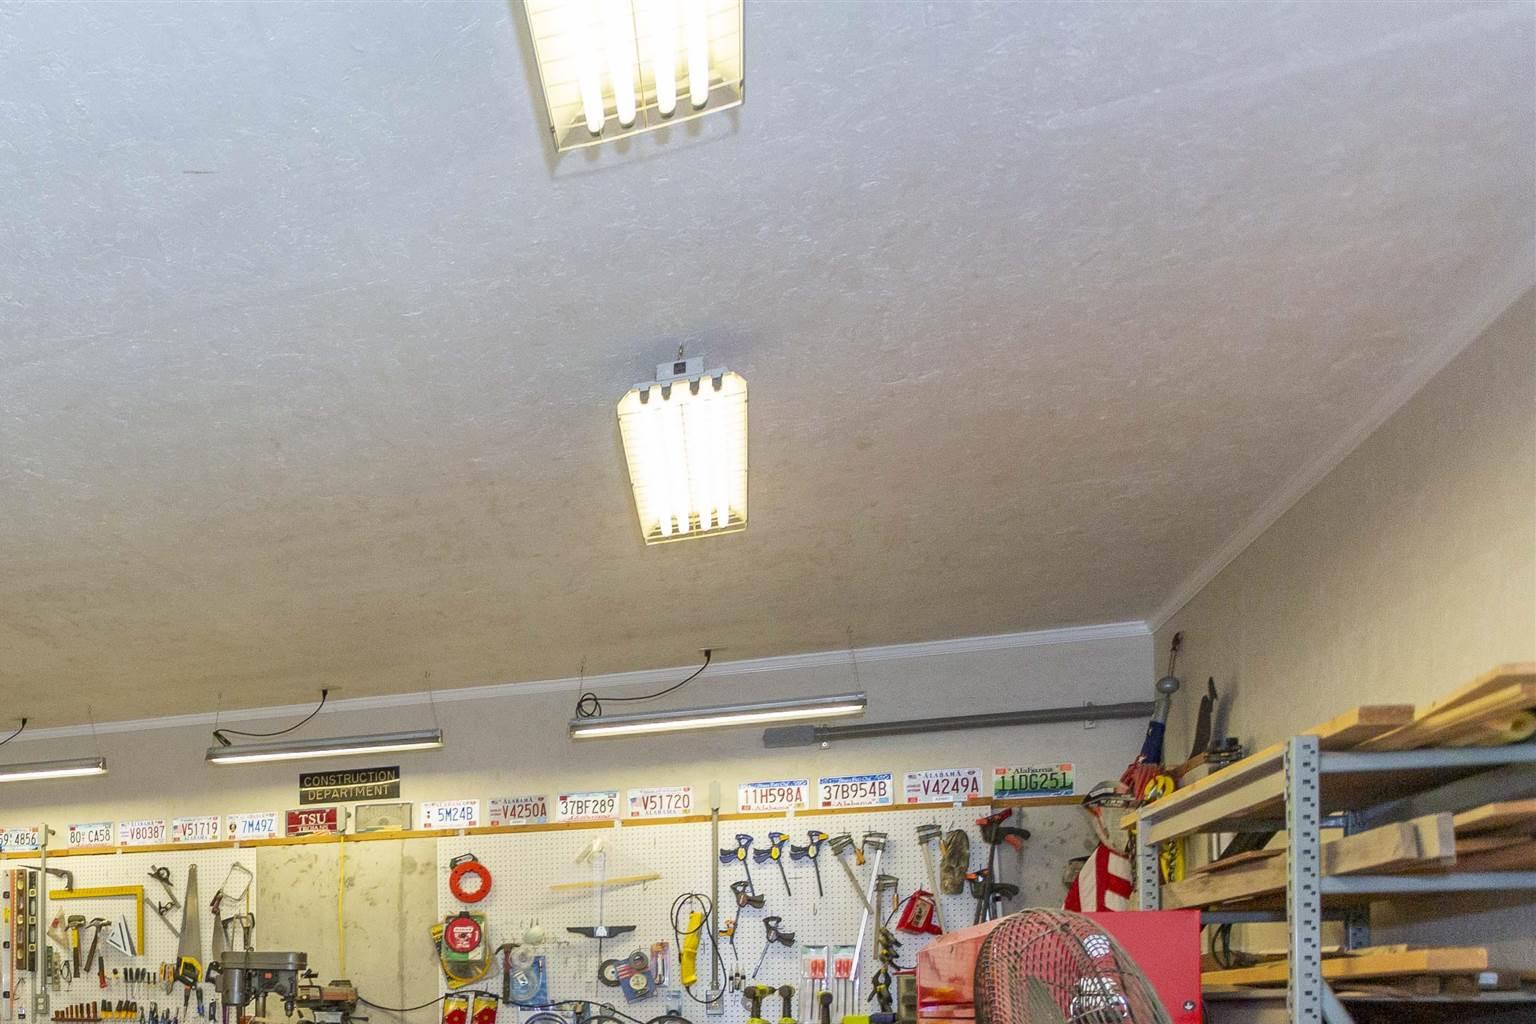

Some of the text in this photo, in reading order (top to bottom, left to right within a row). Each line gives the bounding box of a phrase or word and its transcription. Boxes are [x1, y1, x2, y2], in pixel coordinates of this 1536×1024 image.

[304, 770, 396, 787] CONSTRUCTION
[922, 776, 979, 796] V4249A
[1001, 772, 1067, 791] 11DG251
[308, 784, 390, 801] DEPARTMENT
[745, 787, 802, 804] 11H598A
[824, 781, 887, 800] 37B954B
[561, 799, 615, 815] 37BF289
[642, 794, 690, 810] V51720
[438, 806, 473, 822] 5M24B
[502, 803, 547, 819] V4250A
[298, 813, 327, 826] TSU
[70, 831, 81, 844] 80
[130, 825, 165, 840] V80387
[182, 822, 218, 837] V51719
